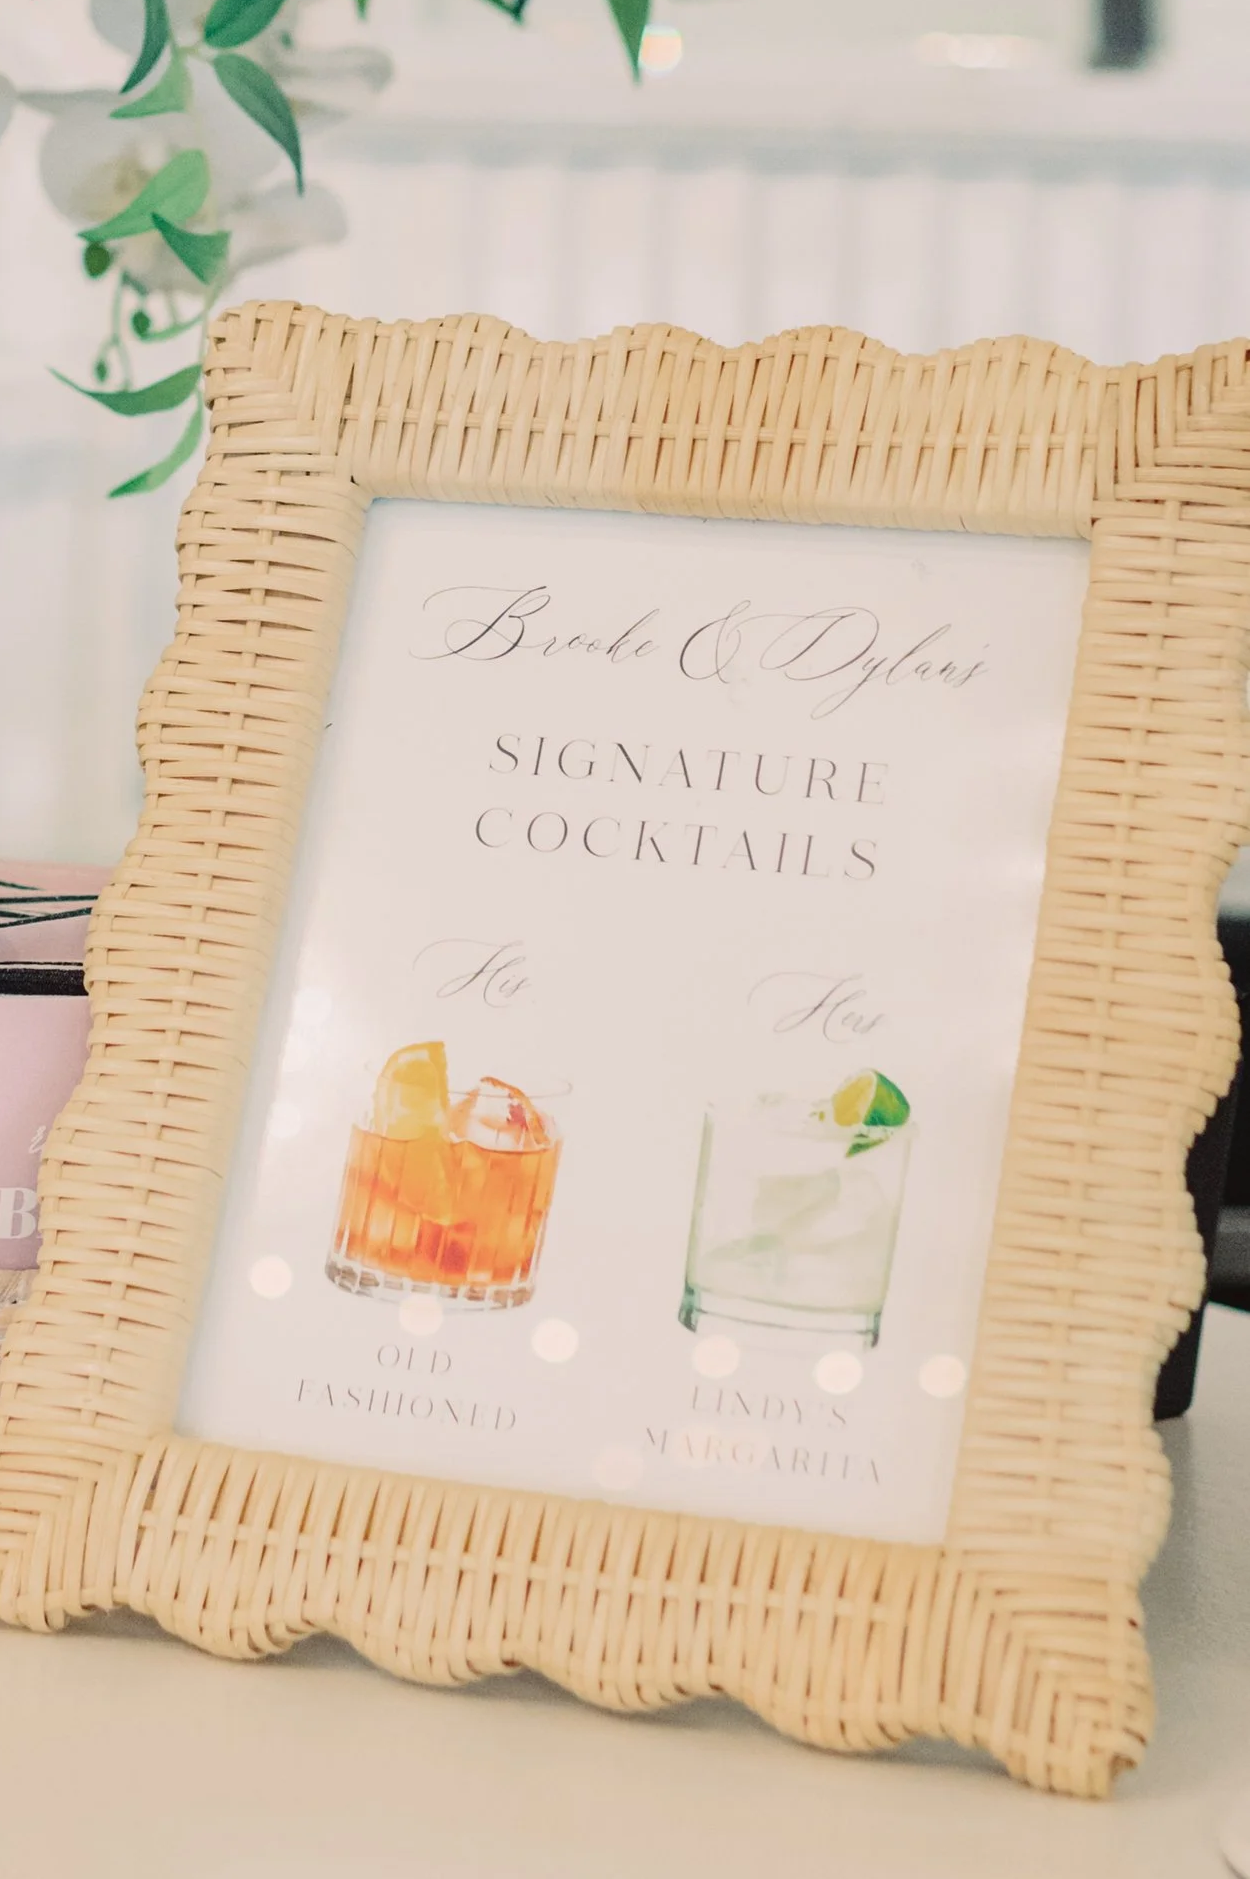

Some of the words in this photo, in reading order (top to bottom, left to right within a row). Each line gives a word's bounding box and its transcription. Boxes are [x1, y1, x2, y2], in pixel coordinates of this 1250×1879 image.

[409, 585, 661, 663] Brooke
[679, 599, 752, 684] &
[724, 605, 990, 721] Dylan's
[488, 733, 890, 805] SIGNATURE
[474, 807, 879, 882] COCKTAILS
[412, 937, 532, 1009] His
[746, 970, 888, 1045] Hers
[377, 1343, 452, 1375] OLD
[296, 1378, 517, 1433] FASHIONED
[646, 1425, 882, 1485] MARGARITA
